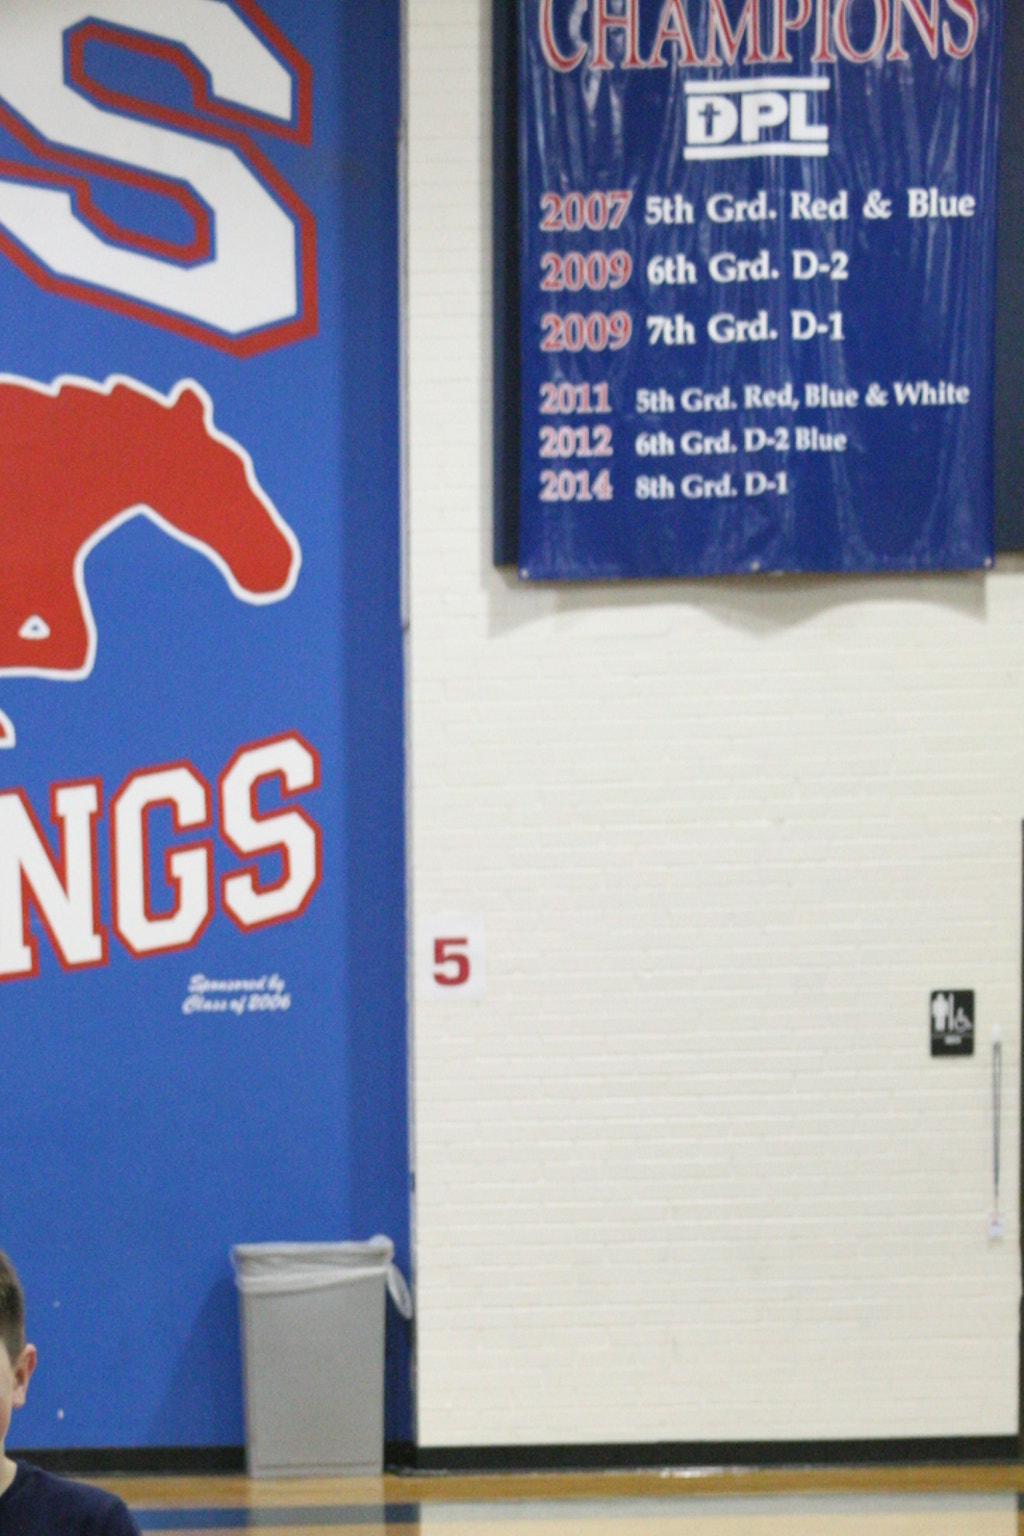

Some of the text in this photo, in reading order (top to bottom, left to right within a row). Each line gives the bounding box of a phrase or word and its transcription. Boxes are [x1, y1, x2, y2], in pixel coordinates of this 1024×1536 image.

[539, 0, 978, 71] CHAMPIONS
[685, 91, 829, 145] DPL
[540, 188, 976, 231] 2007 5th Grd. Red & Blue
[540, 251, 849, 291] 2009 6th Grd. D-2
[540, 311, 845, 351] 2009 7th Grd. D-1
[539, 382, 970, 414] 2011 5th Grd. Red, Blue & White
[539, 425, 848, 458] 2012 6th Grd. D-2 Blue
[539, 470, 613, 501] 2014
[681, 474, 738, 498] Grd.
[745, 472, 789, 495] D-1
[433, 937, 470, 986] 5
[188, 973, 285, 994] Sponsored by
[182, 995, 226, 1014] Class
[230, 995, 246, 1015] of
